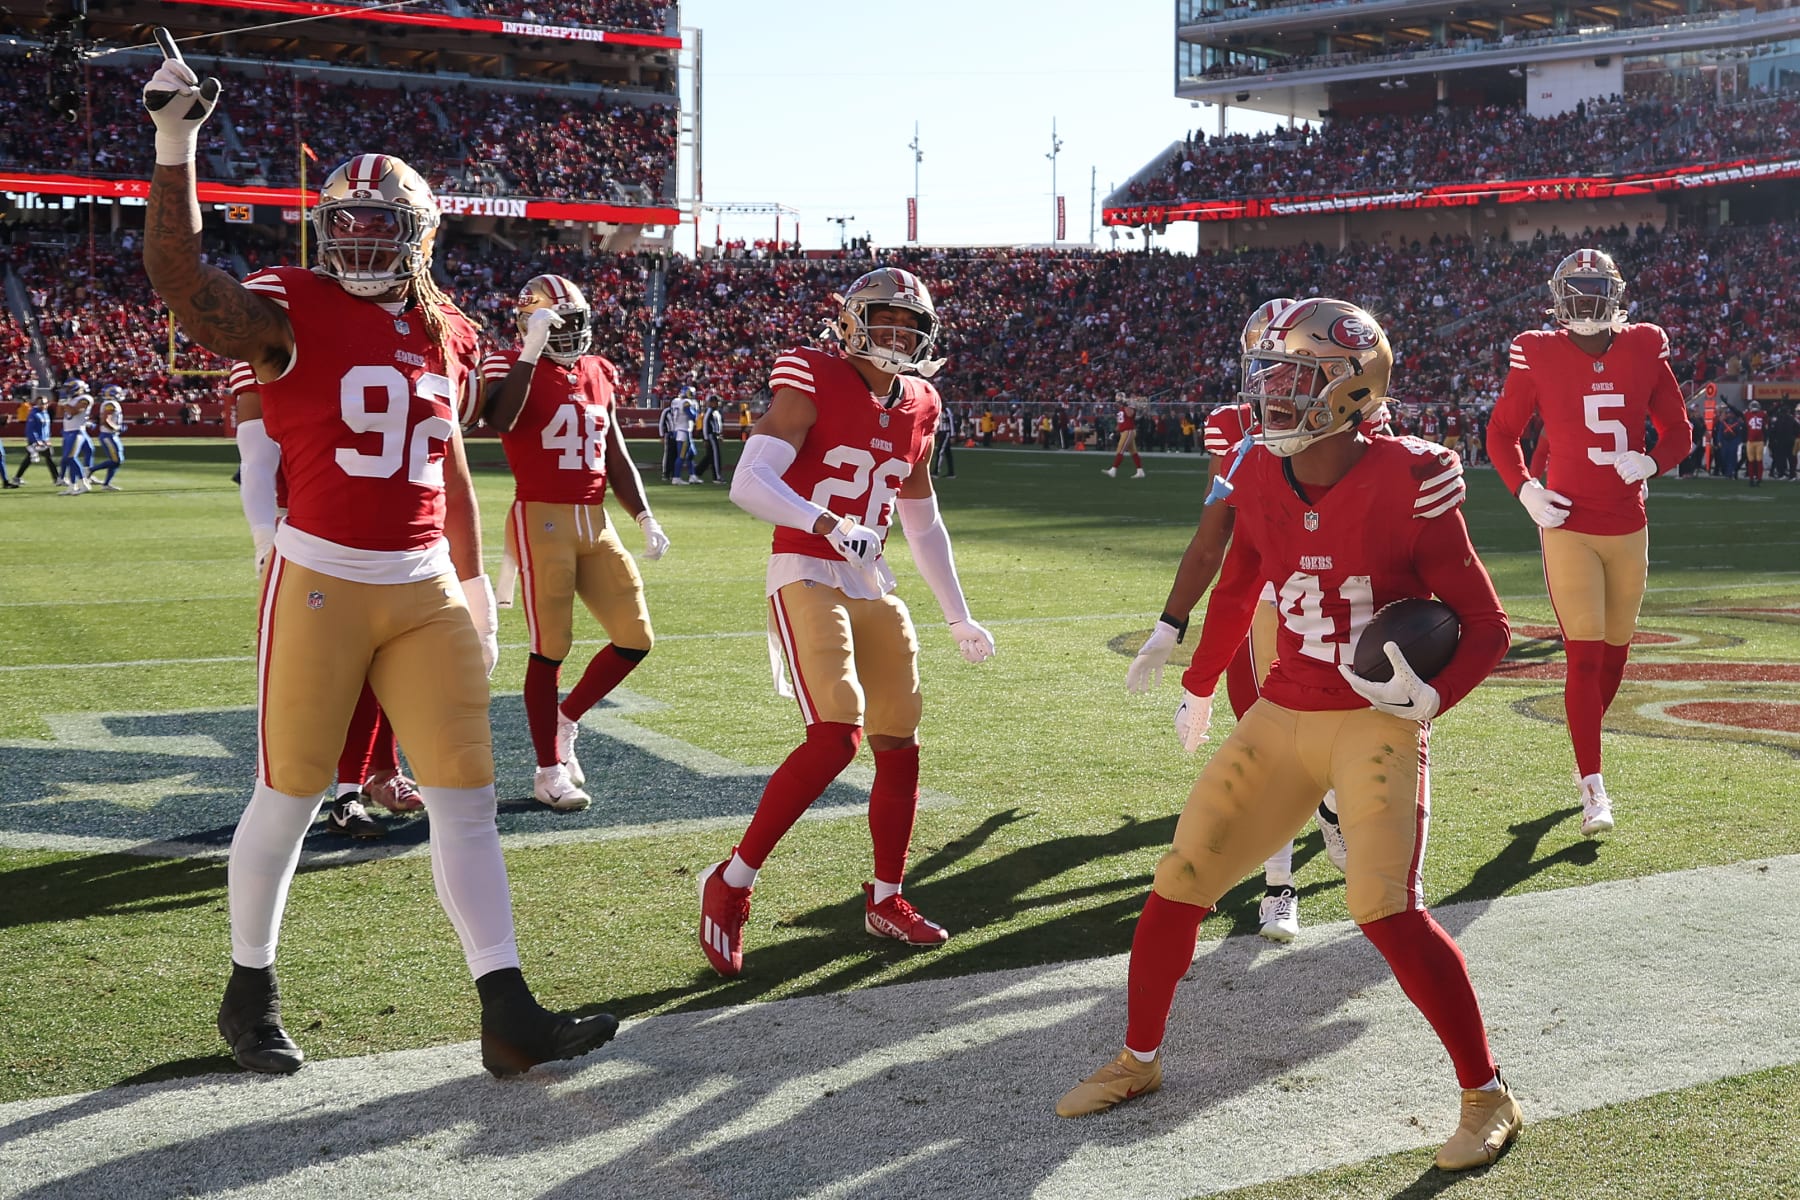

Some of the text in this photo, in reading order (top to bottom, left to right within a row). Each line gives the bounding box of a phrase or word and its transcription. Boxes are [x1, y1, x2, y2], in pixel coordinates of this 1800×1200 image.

[502, 21, 604, 41] INTERCEPTION
[229, 206, 250, 220] 25
[436, 195, 528, 217] EPTION
[335, 366, 457, 487] 92
[541, 404, 611, 470] 48
[1583, 394, 1628, 466] 5
[1749, 417, 1763, 429] 45
[811, 444, 912, 542] 26
[1300, 555, 1333, 570] 49ERS
[1279, 571, 1374, 665] 41
